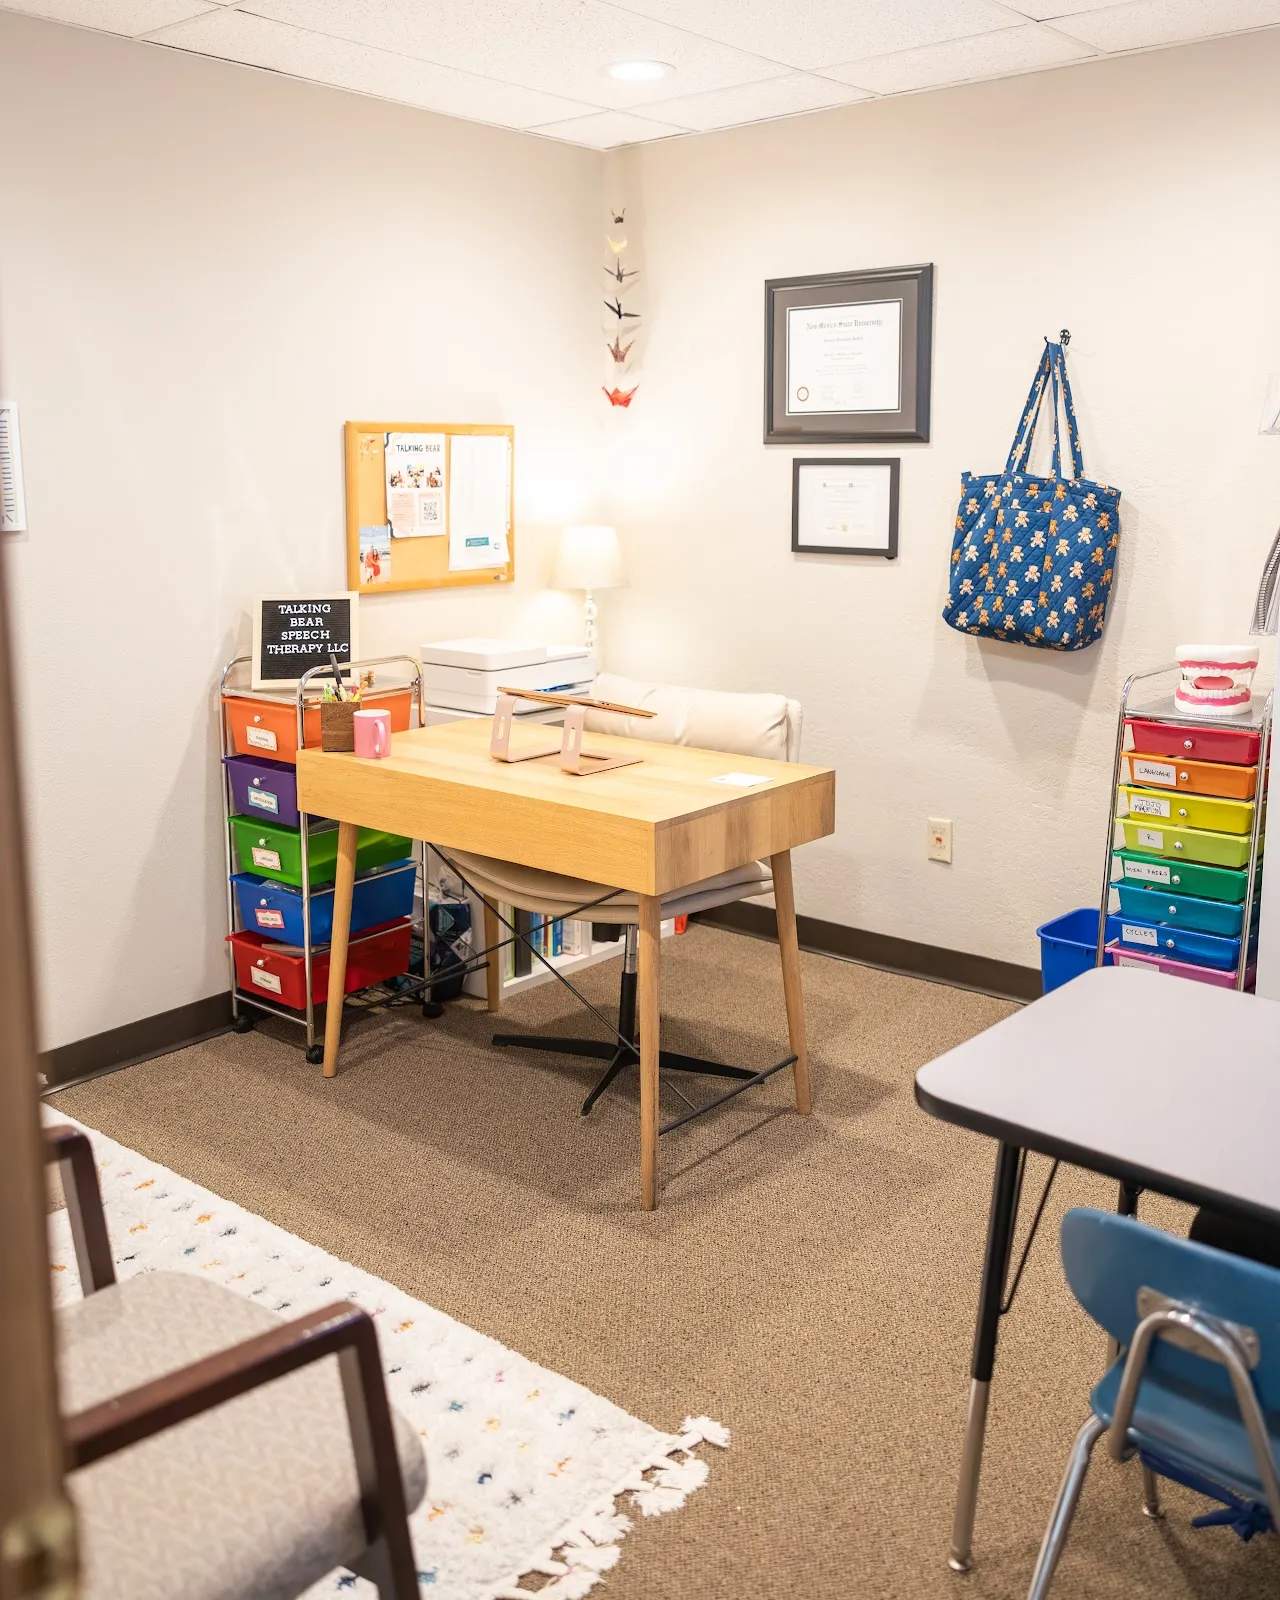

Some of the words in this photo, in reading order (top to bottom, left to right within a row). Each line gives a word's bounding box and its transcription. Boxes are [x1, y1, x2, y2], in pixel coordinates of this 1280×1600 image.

[396, 444, 423, 453] TALKING
[278, 603, 332, 615] TALKING
[289, 617, 324, 628] BEAR
[281, 629, 331, 641] SPEECH
[266, 643, 324, 655] THERAPY
[327, 643, 349, 653] LLC
